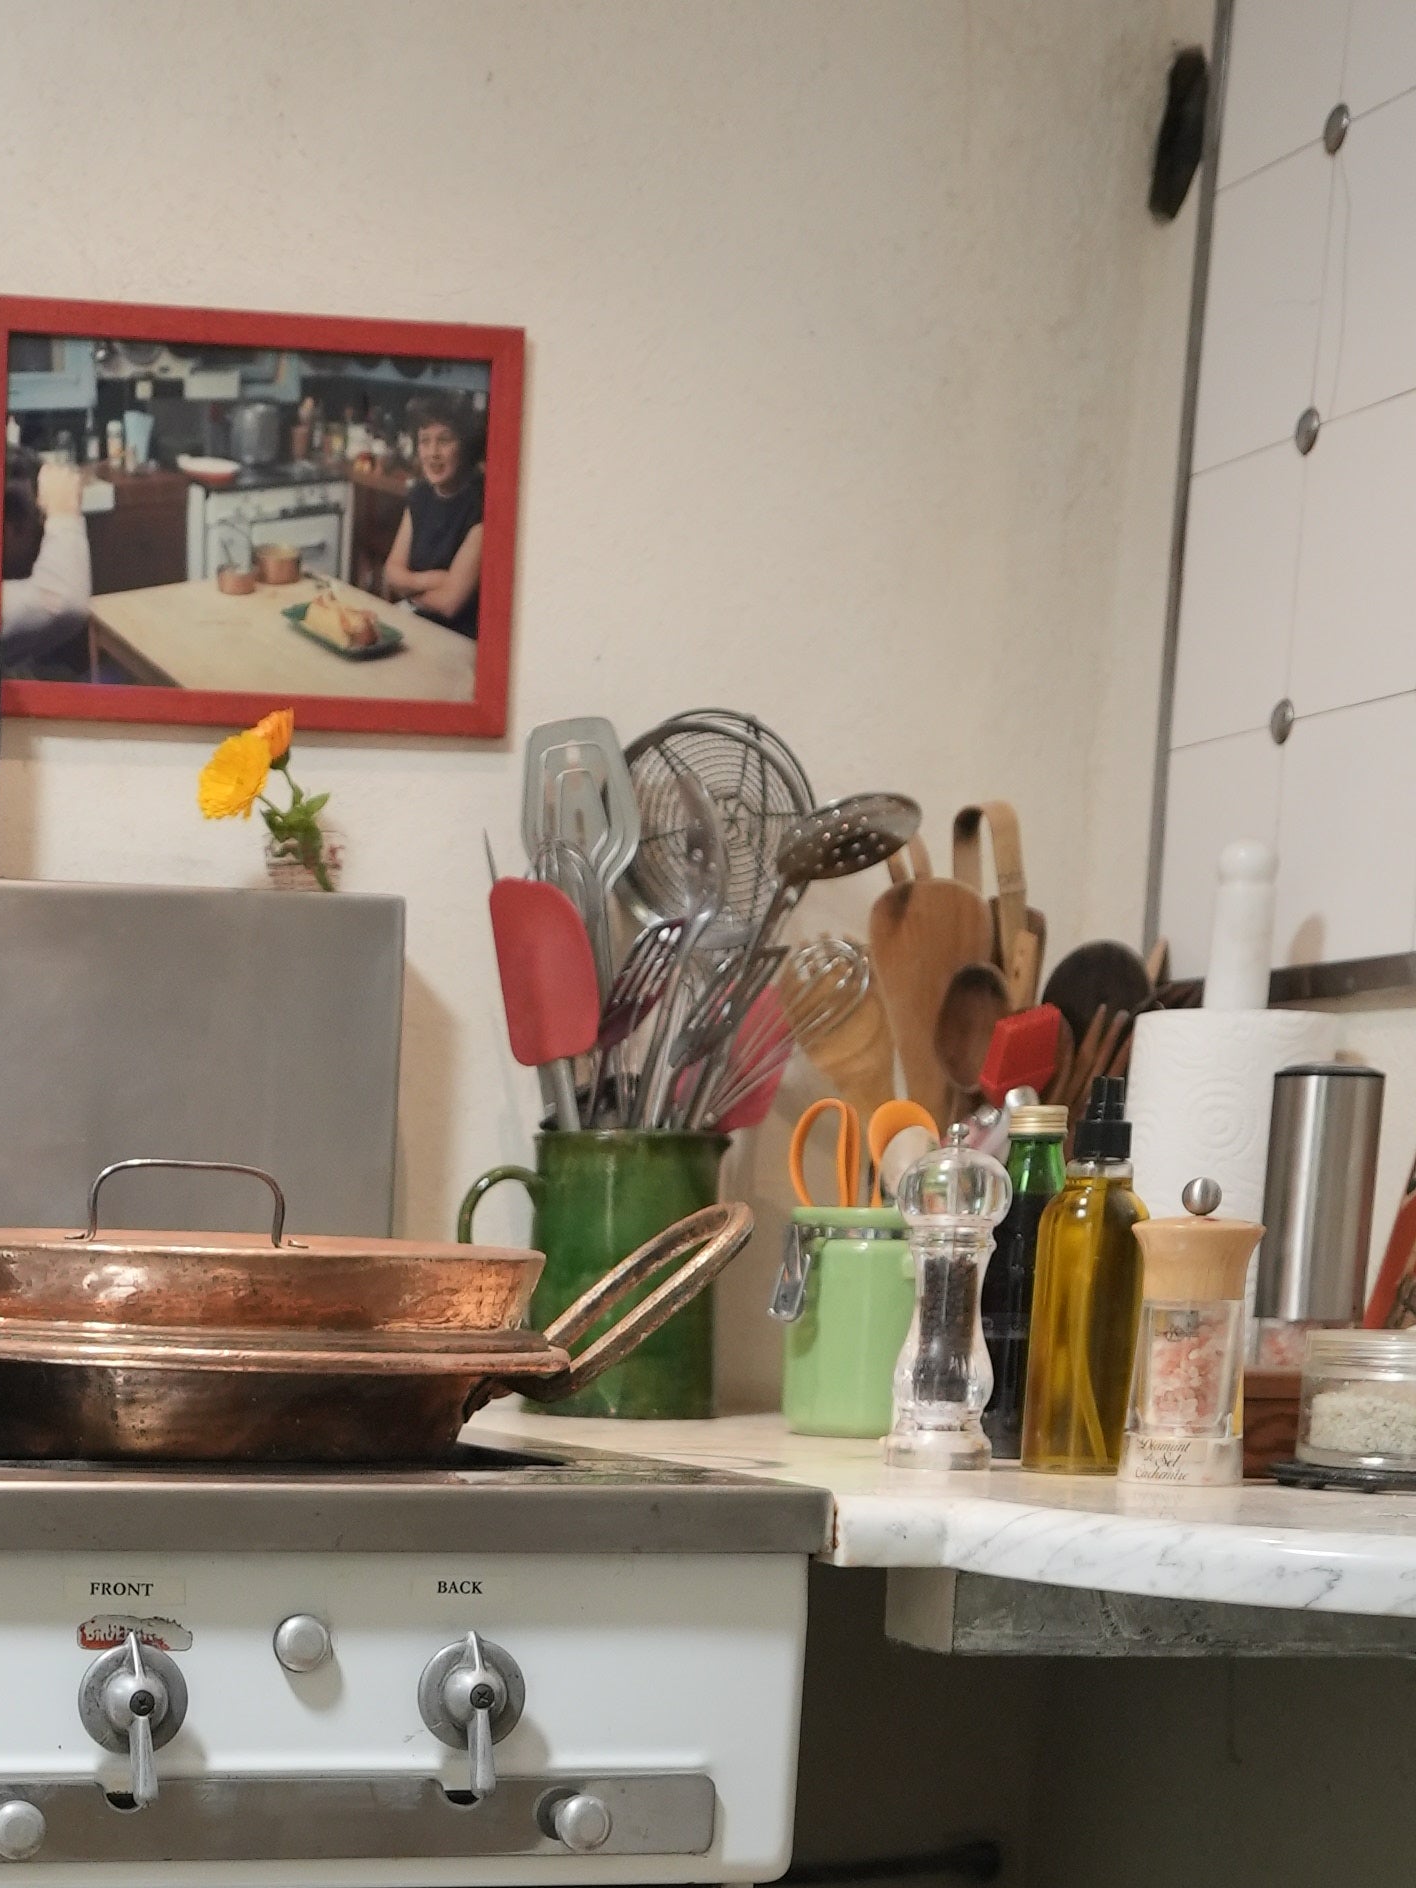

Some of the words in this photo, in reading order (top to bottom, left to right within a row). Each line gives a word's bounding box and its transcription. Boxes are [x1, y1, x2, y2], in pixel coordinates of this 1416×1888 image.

[1154, 1453, 1182, 1468] Sel
[89, 1581, 155, 1597] FRONT
[436, 1580, 483, 1595] BACK
